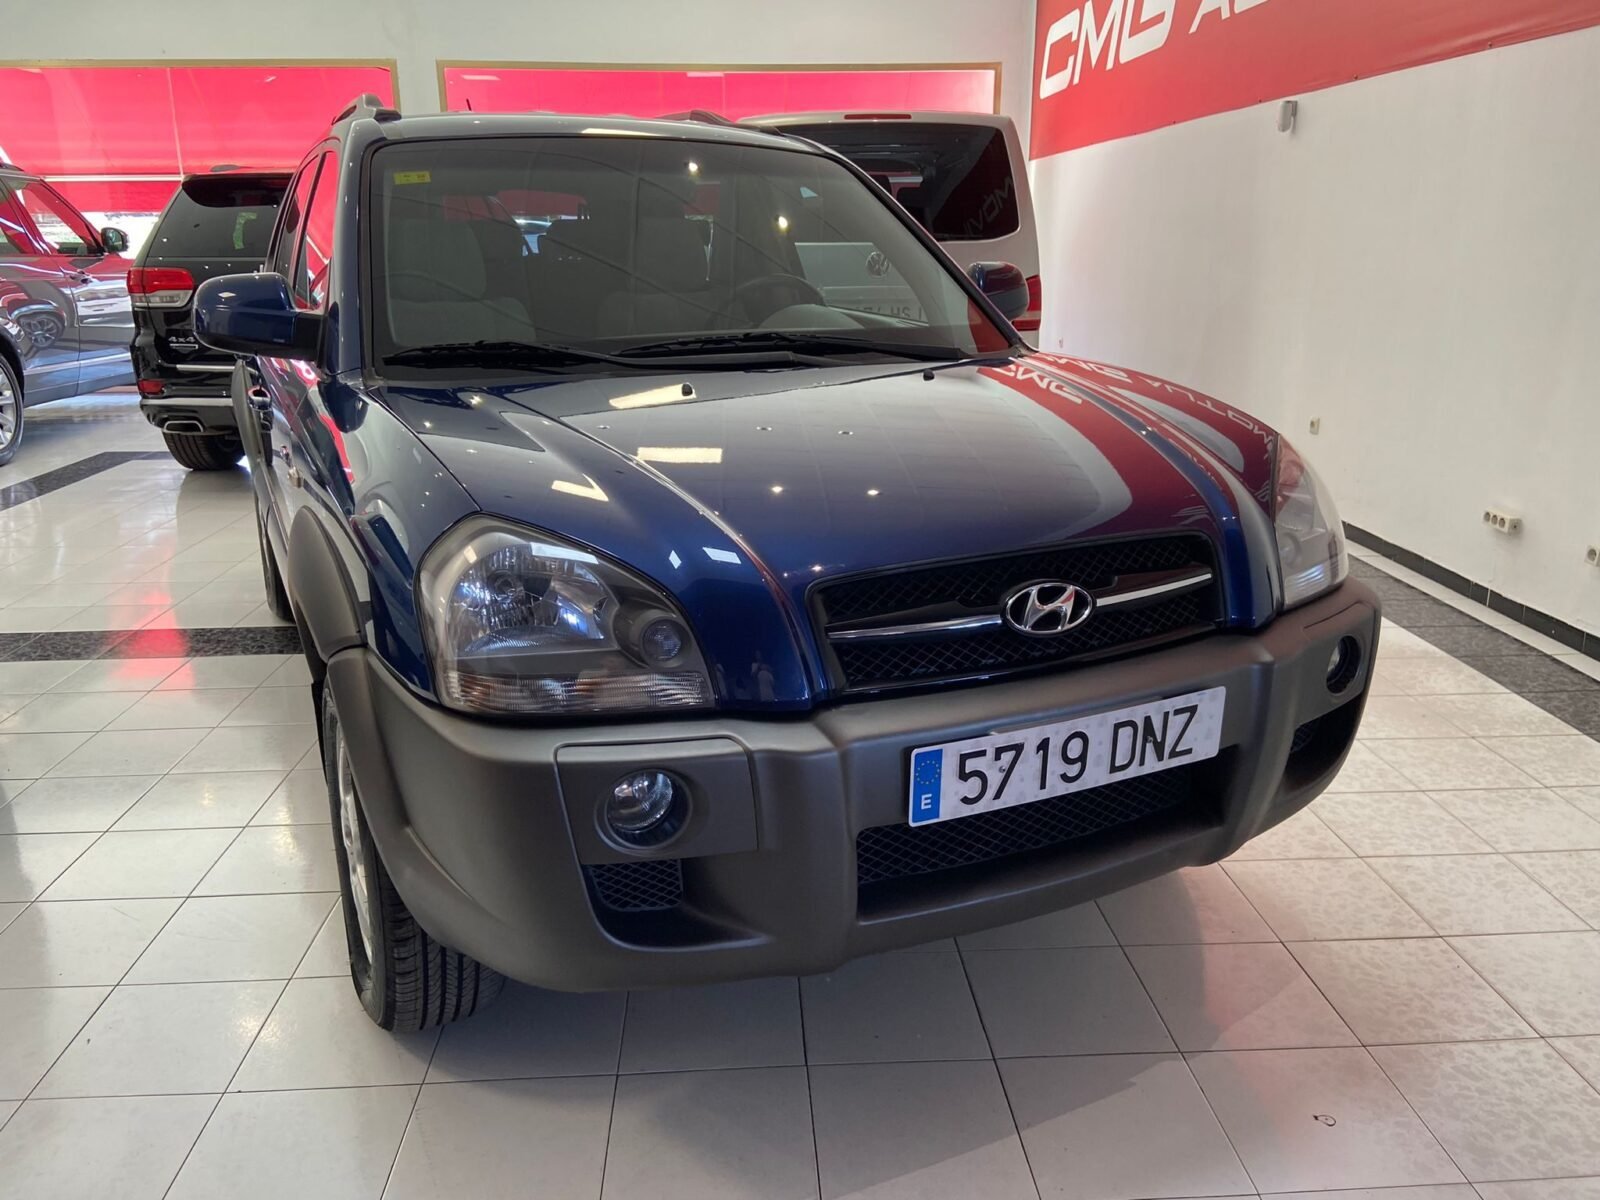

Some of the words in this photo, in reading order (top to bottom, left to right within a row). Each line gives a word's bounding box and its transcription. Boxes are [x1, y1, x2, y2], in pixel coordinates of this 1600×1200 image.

[958, 730, 1090, 806] 5719
[1108, 703, 1199, 775] DNZ
[920, 793, 933, 810] E
